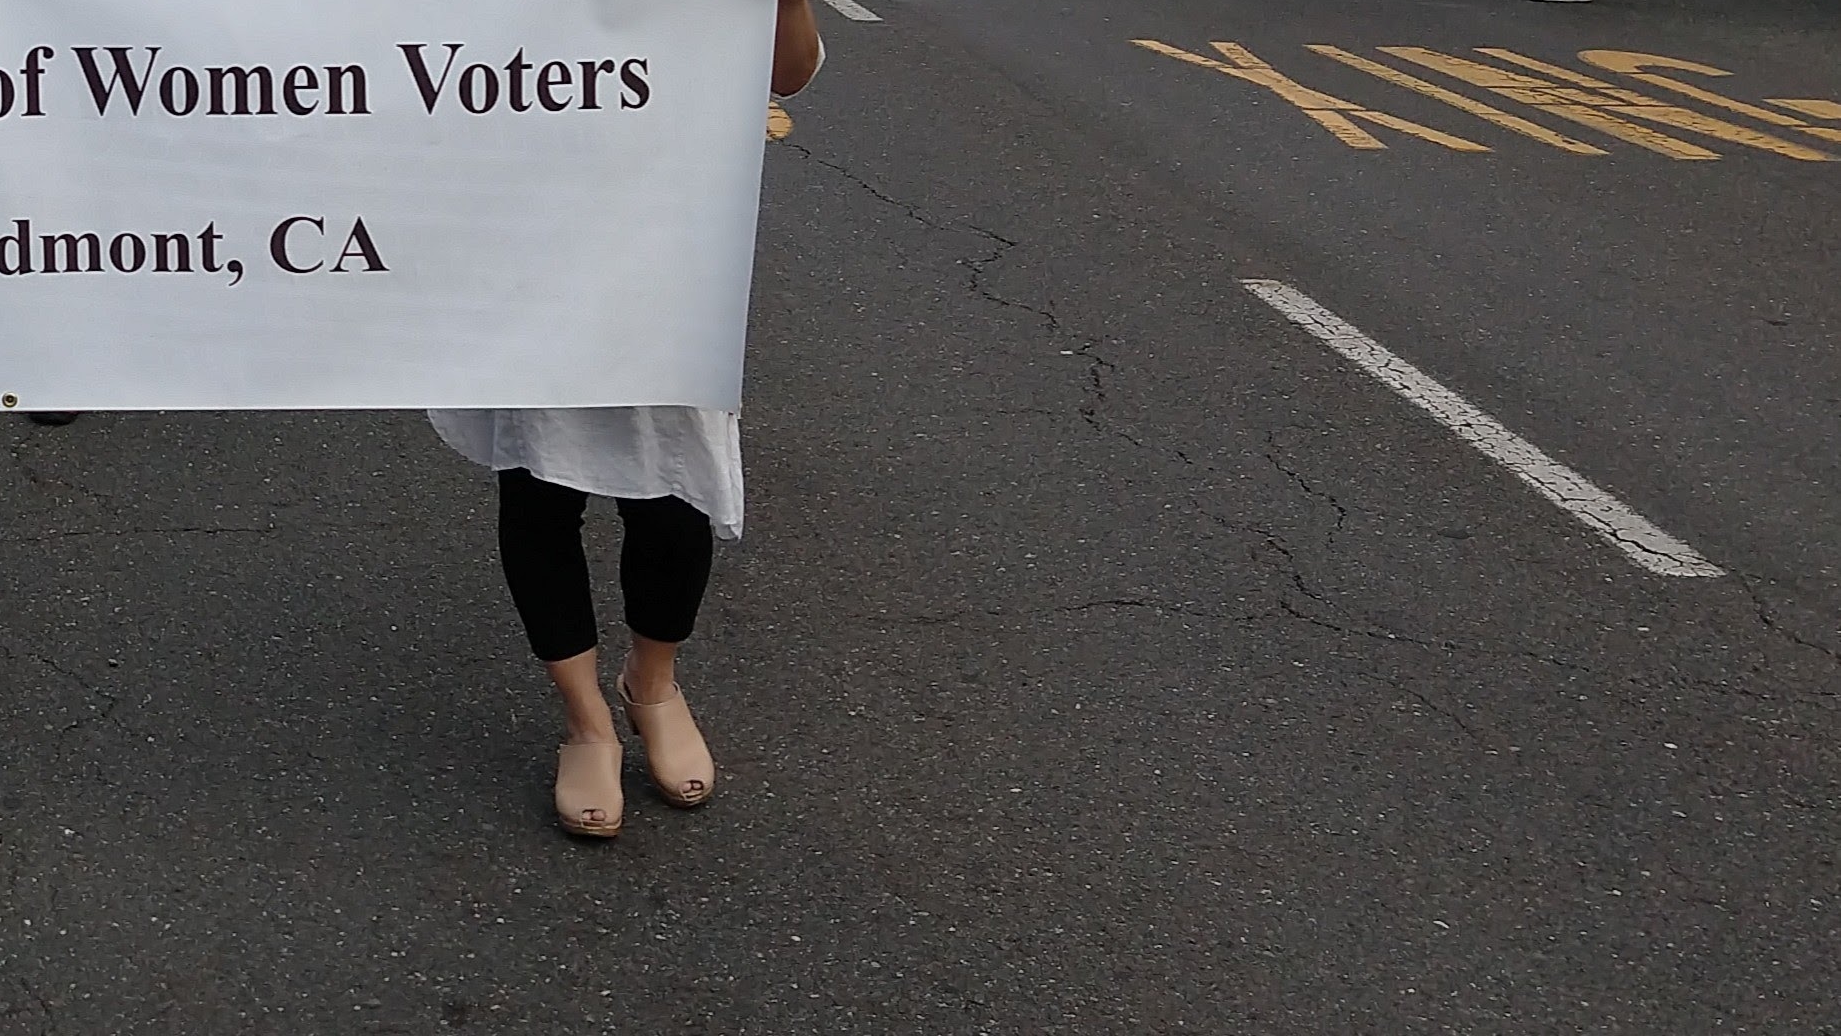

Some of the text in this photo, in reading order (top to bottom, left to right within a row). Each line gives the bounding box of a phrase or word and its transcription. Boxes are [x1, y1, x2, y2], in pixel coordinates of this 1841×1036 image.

[71, 45, 372, 118] Women
[396, 42, 652, 115] Voters
[268, 214, 389, 276] CA
